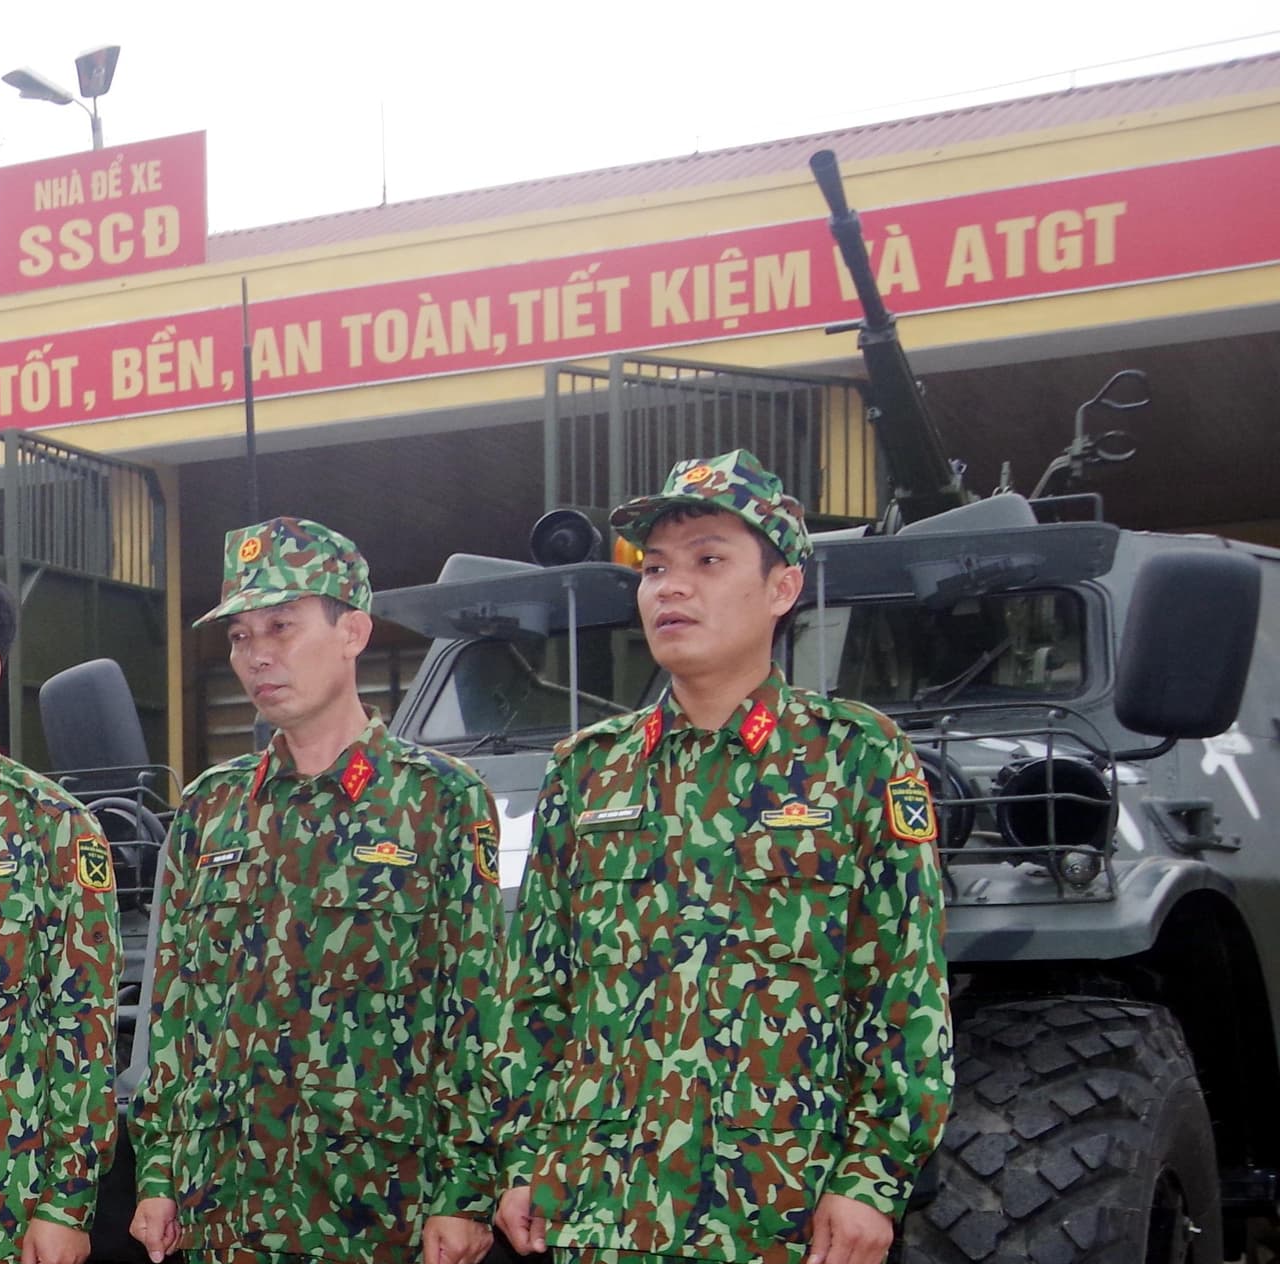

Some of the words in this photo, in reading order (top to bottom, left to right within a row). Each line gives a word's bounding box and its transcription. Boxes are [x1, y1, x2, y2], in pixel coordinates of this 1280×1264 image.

[34, 168, 85, 212] NHÀ
[91, 153, 124, 202] ĐỂ
[130, 160, 163, 195] XE
[19, 205, 180, 277] SSCĐ
[111, 325, 235, 400] BỀN,
[250, 320, 323, 381] AN
[650, 247, 811, 330] KIỆM
[944, 201, 1127, 288] ATGT
